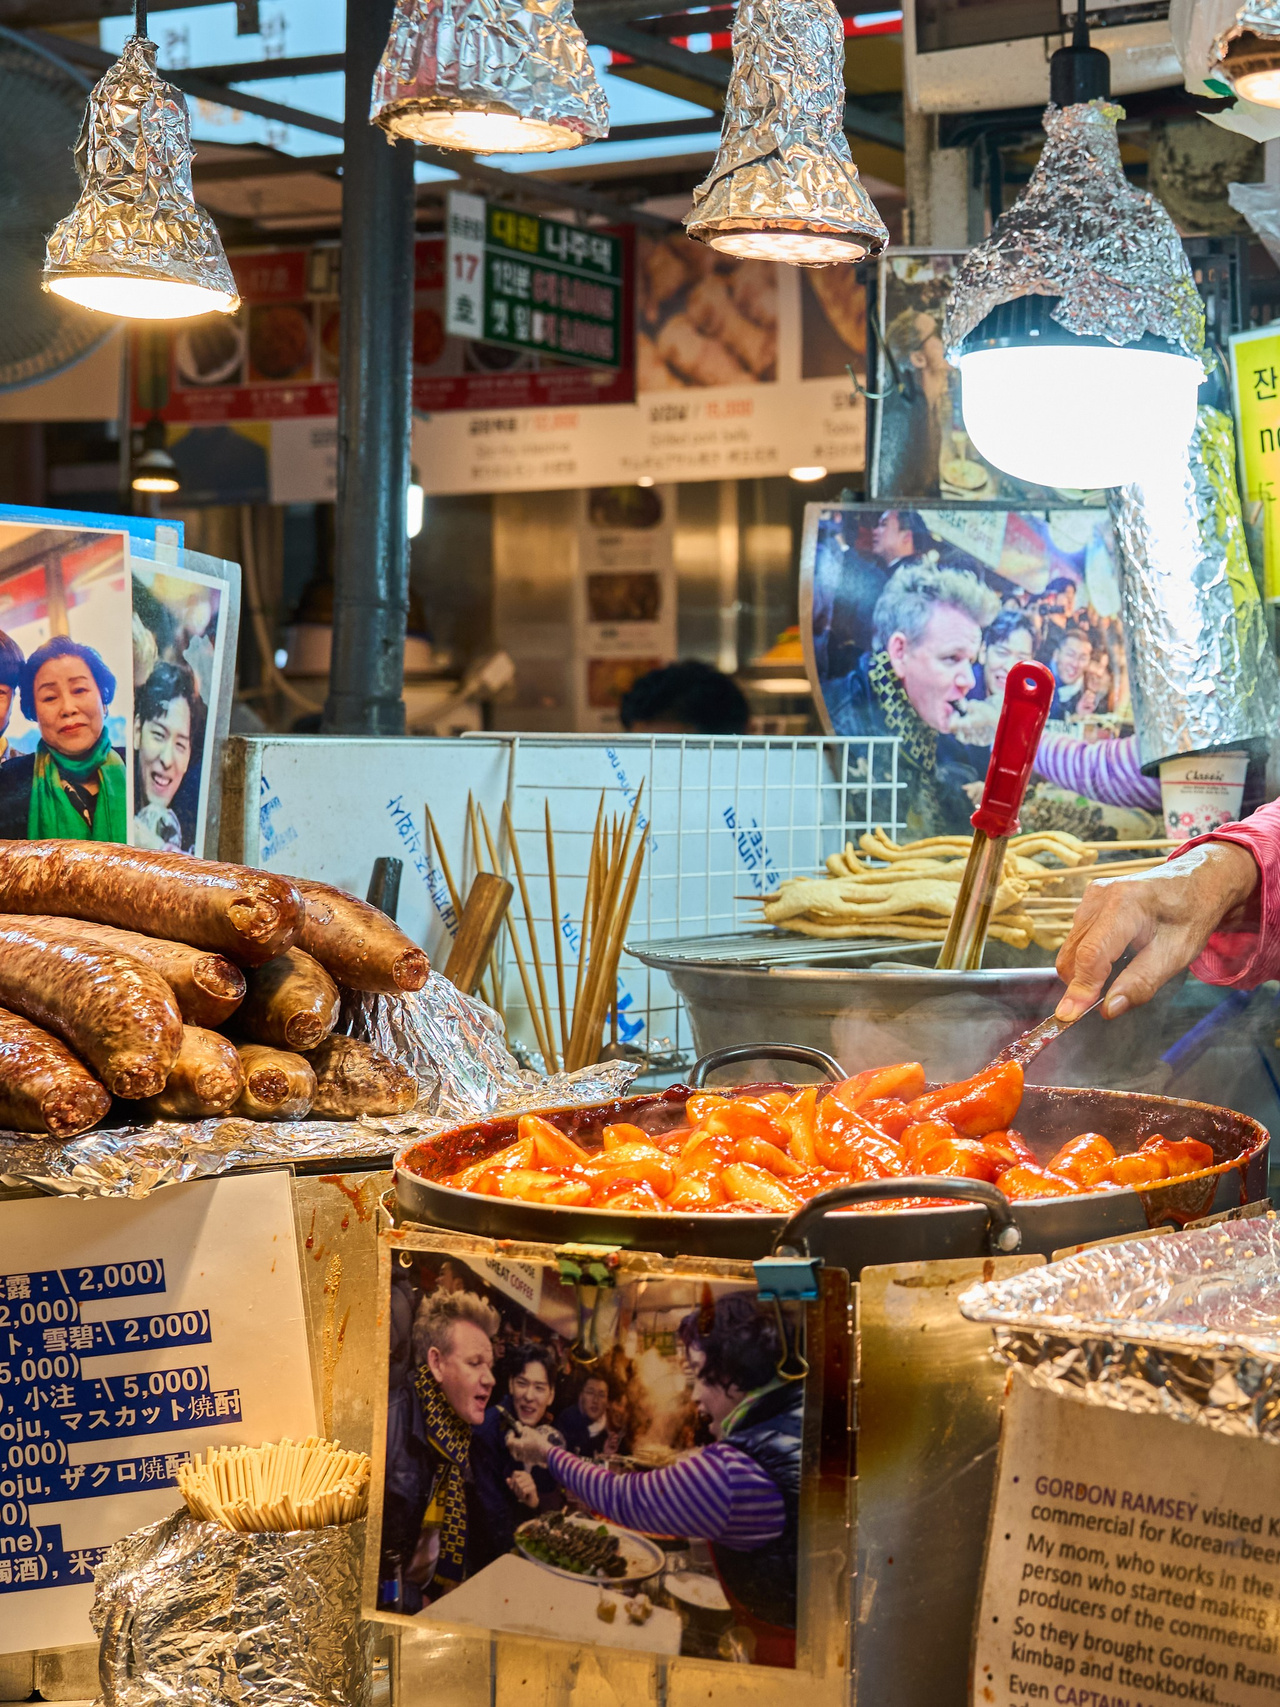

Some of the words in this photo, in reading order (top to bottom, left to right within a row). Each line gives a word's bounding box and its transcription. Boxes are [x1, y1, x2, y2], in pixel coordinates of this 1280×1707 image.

[453, 252, 480, 284] 17
[123, 1309, 209, 1344] 2,000)
[24, 1383, 77, 1412] 小注
[123, 1365, 209, 1400] 5,000)
[1030, 1503, 1136, 1538] commercial
[1139, 1518, 1167, 1543] for
[1169, 1525, 1235, 1557] Korean
[1034, 1475, 1118, 1508] GORDON
[1120, 1490, 1199, 1523] RAMSEY
[1201, 1506, 1264, 1535] visited
[68, 1548, 112, 1577] 米
[1026, 1532, 1056, 1559] My
[1058, 1541, 1110, 1570] mom,
[1114, 1550, 1156, 1576] who
[1159, 1560, 1216, 1588] works
[1219, 1567, 1238, 1592] in
[1242, 1572, 1275, 1599] the
[1020, 1561, 1084, 1589] person
[1086, 1571, 1127, 1597] who
[1129, 1582, 1197, 1611] started
[1200, 1597, 1270, 1631] making
[1017, 1587, 1108, 1621] producers
[1110, 1603, 1132, 1625] of
[1134, 1609, 1166, 1633] the
[1168, 1617, 1280, 1656] commercial
[1010, 1640, 1076, 1677] kimbap
[1079, 1658, 1115, 1682] and
[1012, 1615, 1036, 1639] So
[1039, 1621, 1080, 1651] they
[1082, 1629, 1155, 1665] brought
[1158, 1646, 1230, 1681] Gordon
[1008, 1673, 1050, 1700] Even
